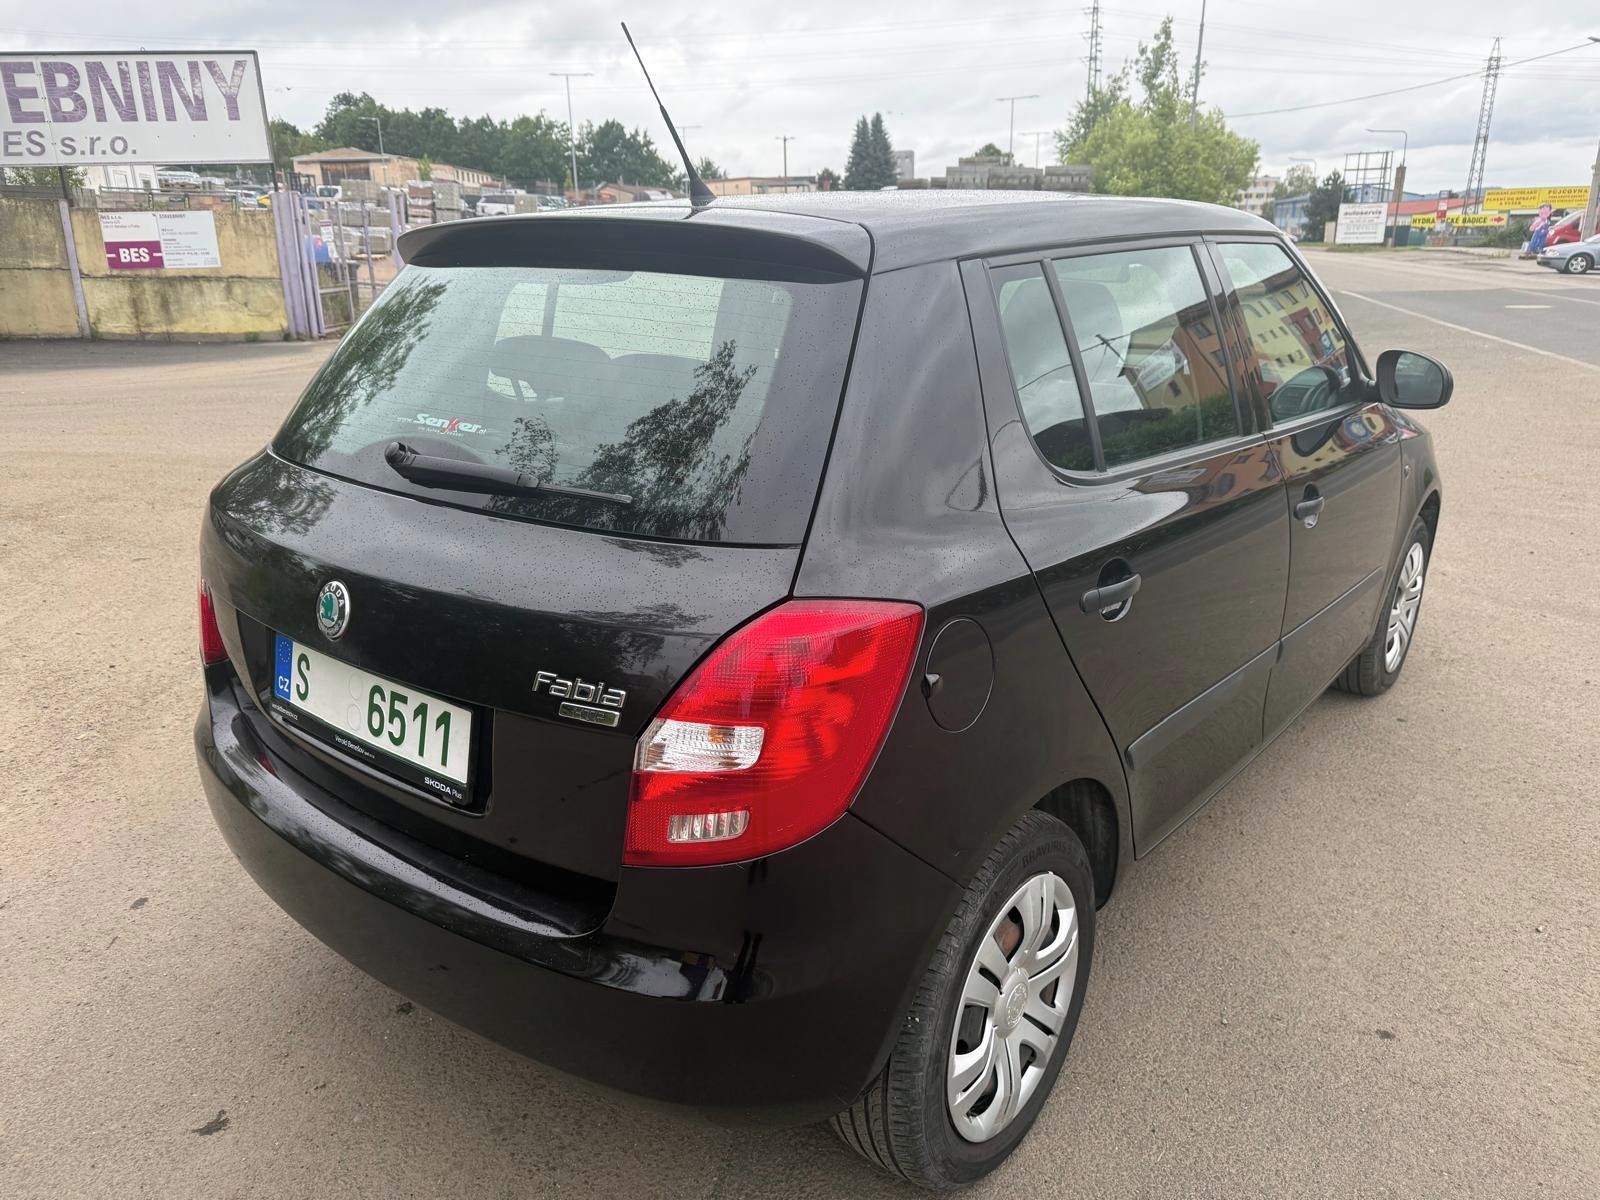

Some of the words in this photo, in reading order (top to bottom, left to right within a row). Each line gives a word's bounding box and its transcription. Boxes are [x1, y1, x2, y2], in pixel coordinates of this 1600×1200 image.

[1, 60, 247, 123] EBNINY
[2, 131, 46, 156] ES
[60, 134, 137, 156] s.r.o.
[119, 247, 150, 263] BES
[278, 675, 290, 693] CZ
[532, 671, 627, 708] Fabia
[295, 653, 311, 701] S
[367, 685, 452, 767] 6511
